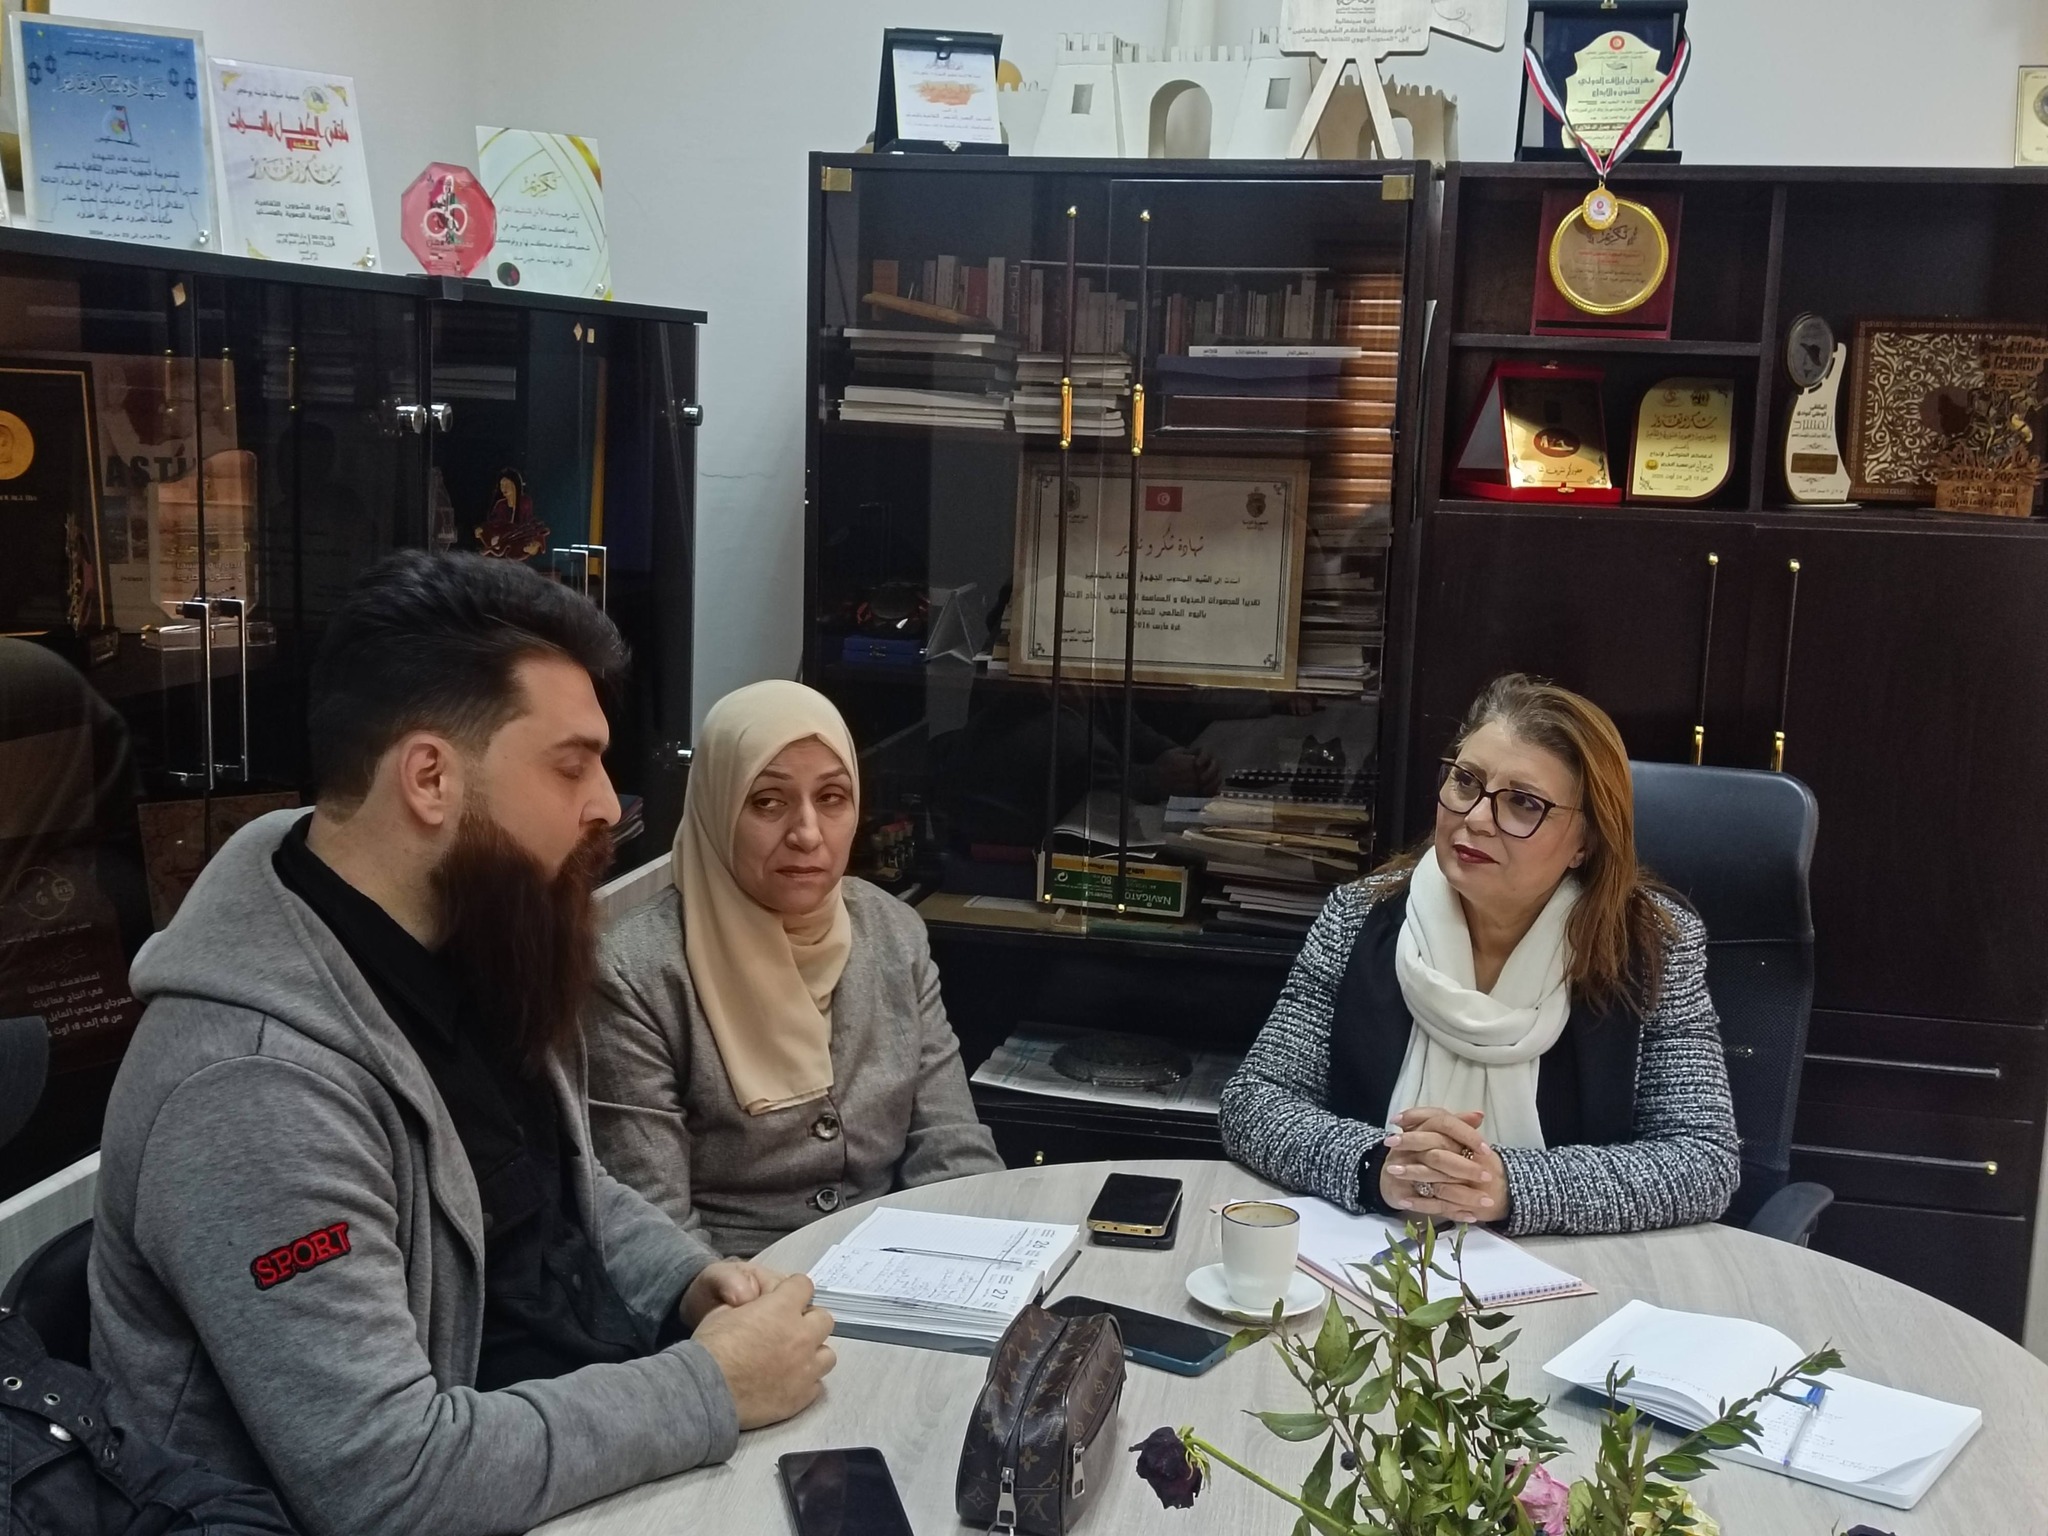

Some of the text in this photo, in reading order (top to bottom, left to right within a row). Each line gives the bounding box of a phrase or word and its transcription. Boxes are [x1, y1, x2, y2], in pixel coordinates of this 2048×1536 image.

[1178, 535, 1205, 558] شهادة
[1124, 891, 1172, 906] NAVIGATO
[103, 996, 133, 1010] مهرجان
[110, 1013, 123, 1024] من
[252, 1222, 350, 1289] SPORT
[990, 1287, 1009, 1301] 27
